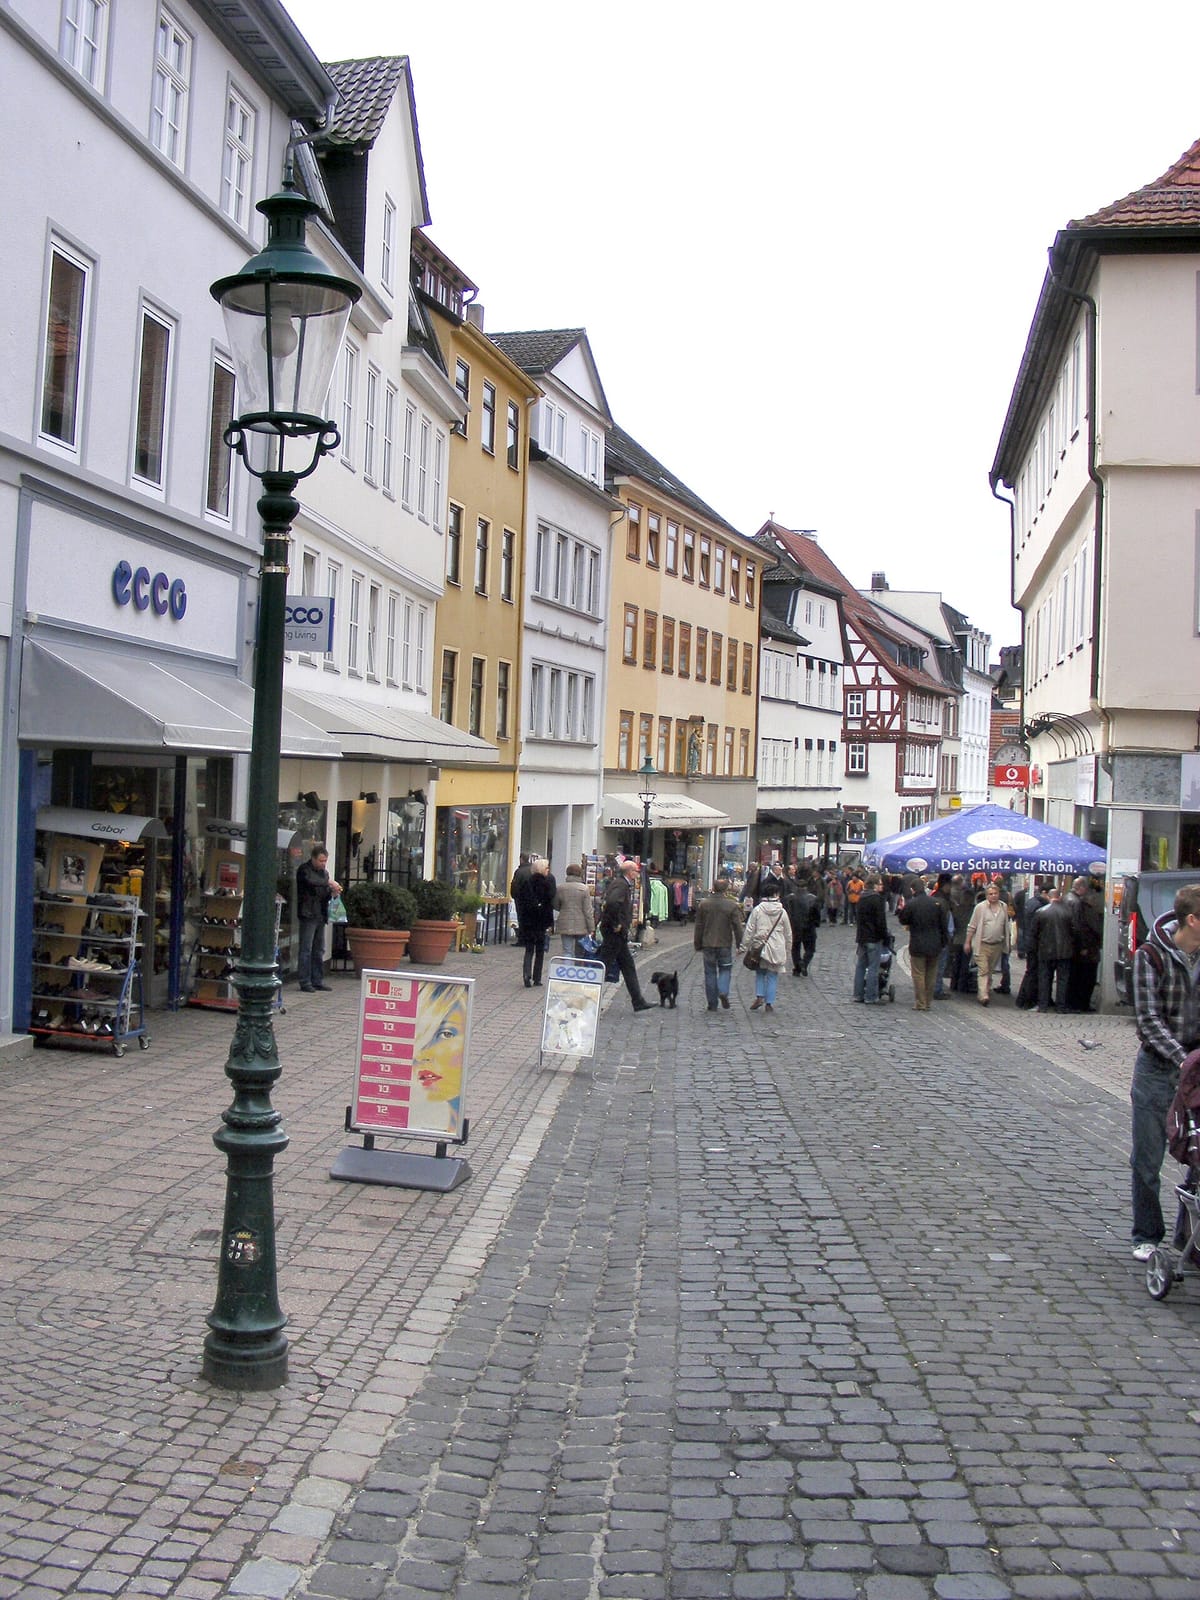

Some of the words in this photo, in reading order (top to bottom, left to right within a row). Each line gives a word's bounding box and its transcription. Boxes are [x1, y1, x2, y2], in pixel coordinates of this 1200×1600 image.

[112, 560, 187, 620] ecco
[285, 606, 323, 624] cco
[91, 822, 125, 834] Gabor
[610, 818, 653, 826] FRANKYS
[941, 859, 964, 870] Der
[968, 858, 1010, 870] Schatz
[1014, 858, 1035, 870] der
[1040, 858, 1077, 874] Rhön.
[556, 966, 596, 980] ecco
